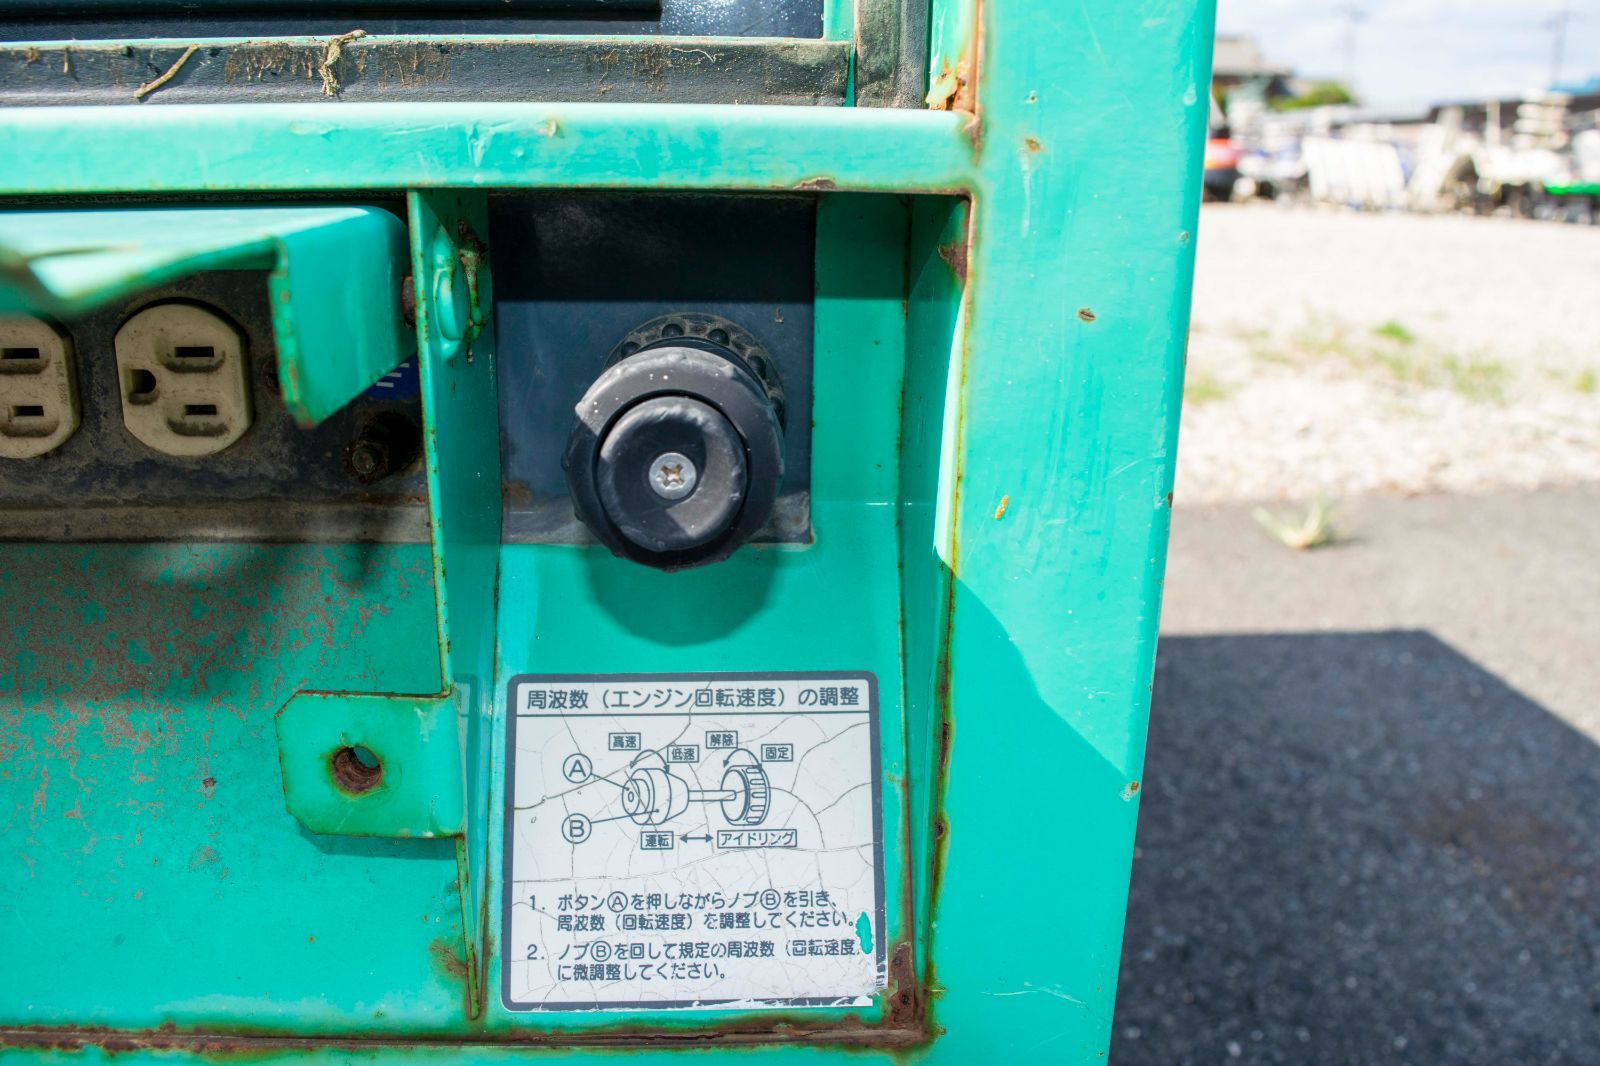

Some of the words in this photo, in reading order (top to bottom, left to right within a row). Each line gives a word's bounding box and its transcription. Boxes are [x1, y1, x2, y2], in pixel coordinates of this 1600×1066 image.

[612, 735, 638, 748] 高速
[710, 733, 735, 747] 解除
[671, 748, 696, 761] 低速
[765, 746, 790, 760] 固定
[644, 834, 671, 848] 運転
[719, 832, 796, 847] アイドリング
[557, 963, 728, 981] に微調整してください。
